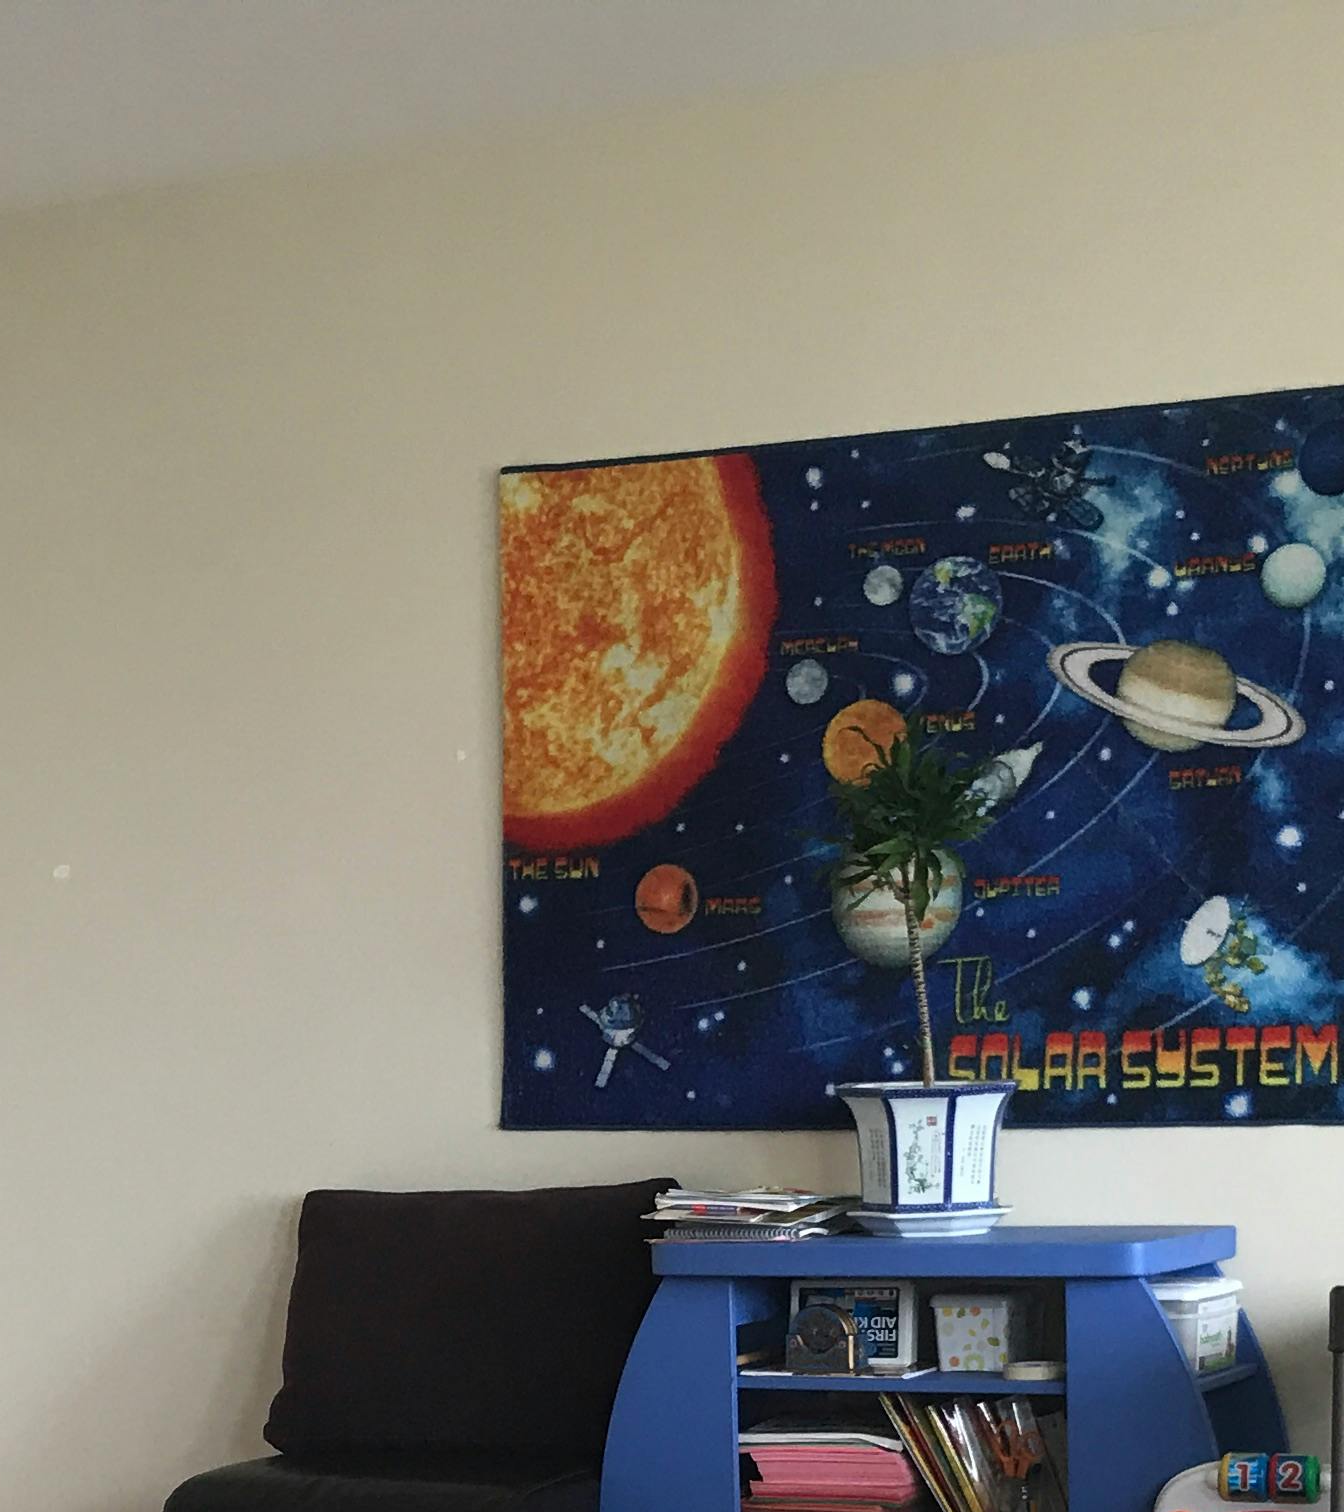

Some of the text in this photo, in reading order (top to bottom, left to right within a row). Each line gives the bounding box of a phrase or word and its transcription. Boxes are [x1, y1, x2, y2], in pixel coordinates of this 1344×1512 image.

[1206, 449, 1294, 476] NEPTUNE
[921, 711, 976, 733] ENUS
[510, 855, 599, 880] THE SUN
[974, 875, 1060, 899] JUPITER
[706, 896, 761, 915] MARS
[938, 956, 1011, 1024] The
[949, 1024, 1338, 1091] SOLAR SYSTEM
[861, 1329, 897, 1342] FIRS
[1235, 1459, 1304, 1490] 1 2
